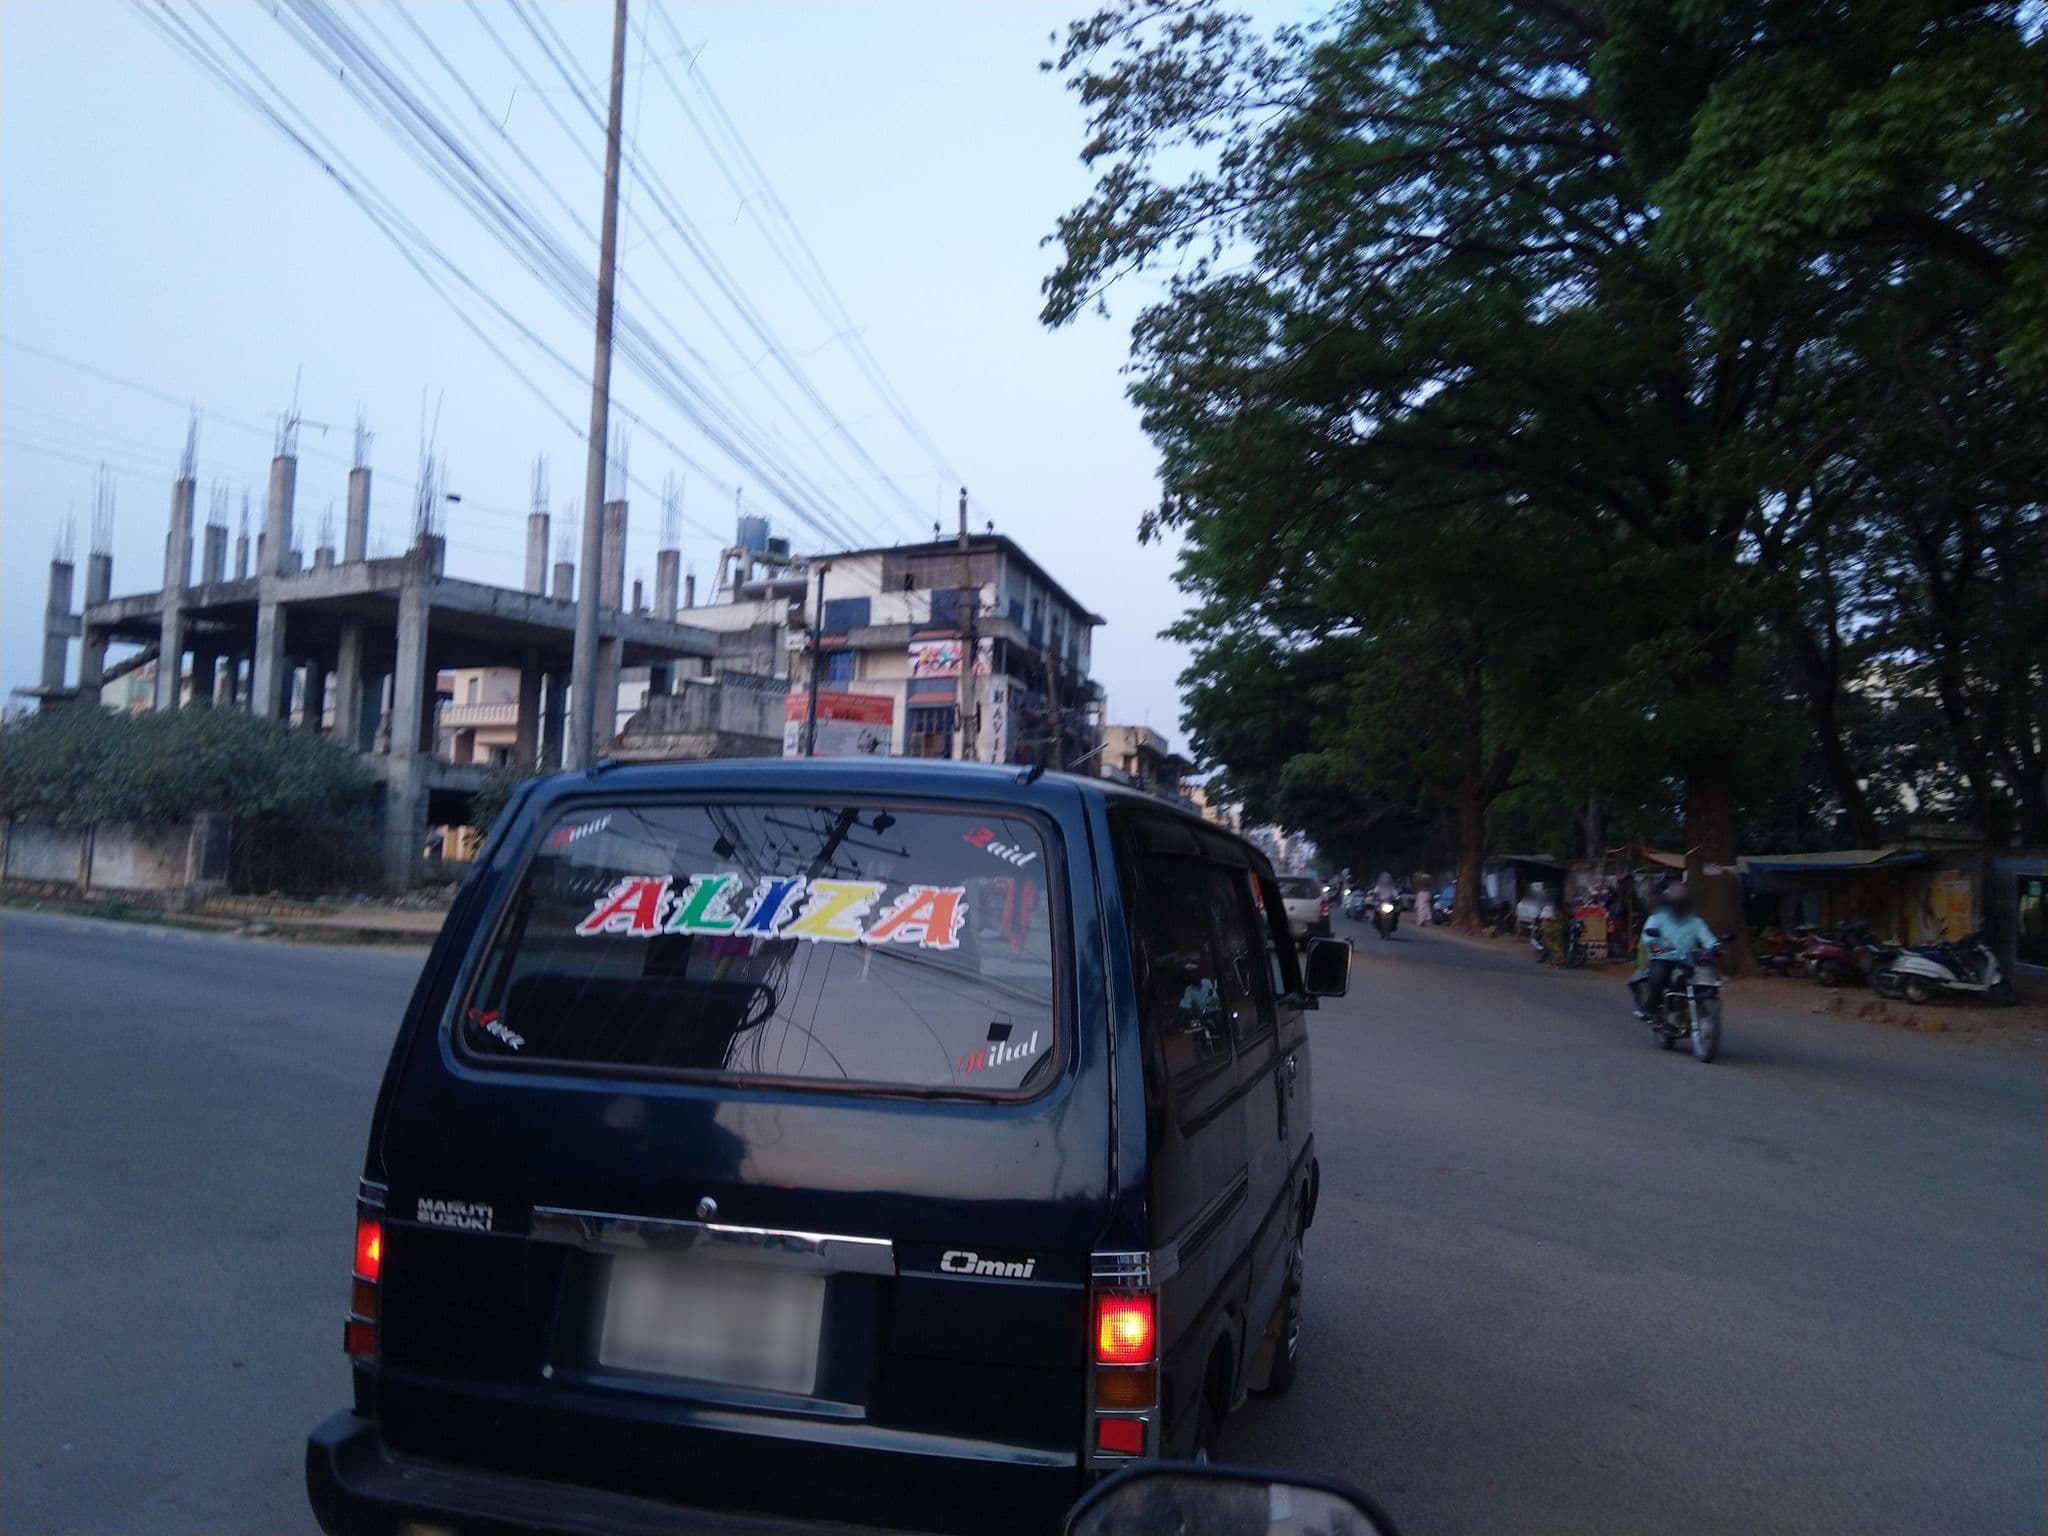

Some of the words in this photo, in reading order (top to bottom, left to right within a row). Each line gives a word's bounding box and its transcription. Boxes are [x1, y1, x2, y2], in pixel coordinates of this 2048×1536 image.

[575, 872, 969, 950] ALIZA
[955, 1030, 1038, 1077] Nihal
[417, 1209, 492, 1232] SUZUKI
[418, 1197, 493, 1219] MARUTI
[940, 1250, 1036, 1279] Omni
